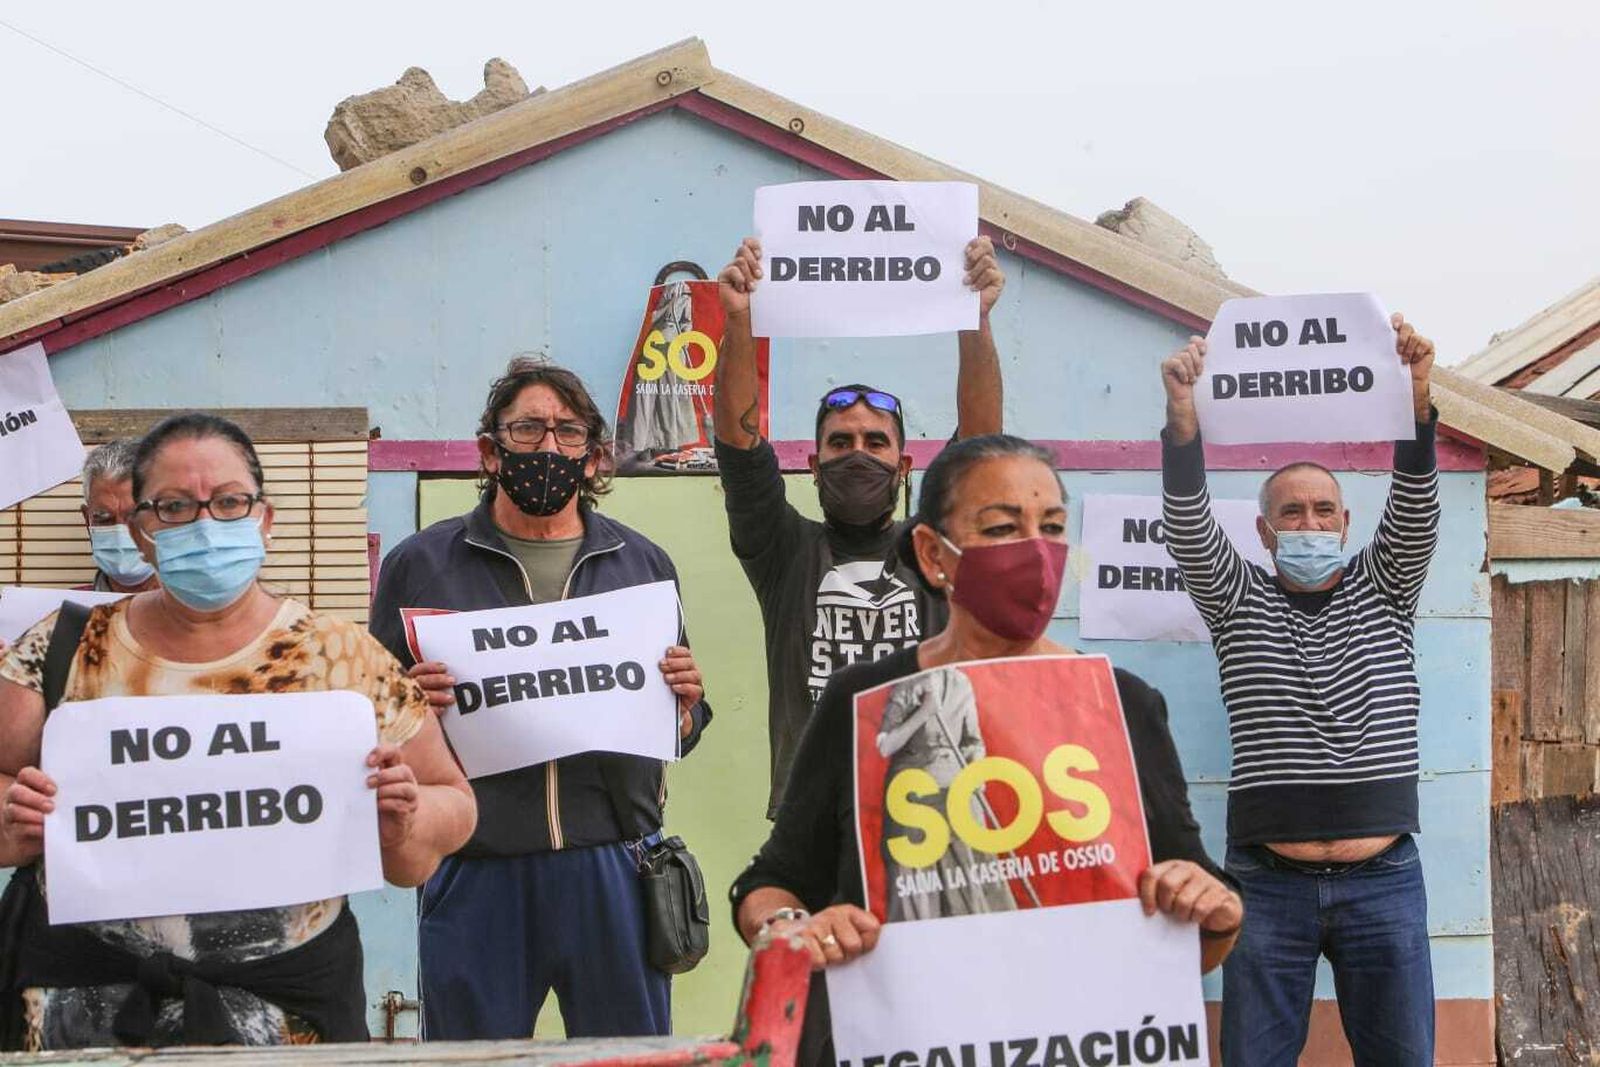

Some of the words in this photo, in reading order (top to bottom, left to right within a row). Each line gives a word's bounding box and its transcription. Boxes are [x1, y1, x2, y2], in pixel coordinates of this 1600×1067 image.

[799, 204, 855, 232] NO
[863, 204, 915, 232] AL
[770, 256, 941, 282] DERRIBO
[1234, 320, 1289, 349] NO
[1298, 318, 1347, 346] AL
[637, 330, 725, 380] SO
[1212, 366, 1374, 400] DERRIBO
[1098, 564, 1188, 592] DERR
[473, 625, 538, 651] NO
[551, 615, 609, 644] AL
[812, 602, 921, 641] NEVER
[453, 661, 646, 716] DERRIBO
[110, 726, 192, 765] NO
[207, 721, 281, 757] AL
[75, 784, 324, 843] DERRIBO
[886, 744, 1111, 868] SOS
[895, 869, 944, 898] SALVA
[946, 865, 967, 890] LA
[1037, 850, 1060, 875] DE
[1063, 843, 1116, 871] OSSIO
[840, 1015, 1199, 1067] ALIZACIÓN
